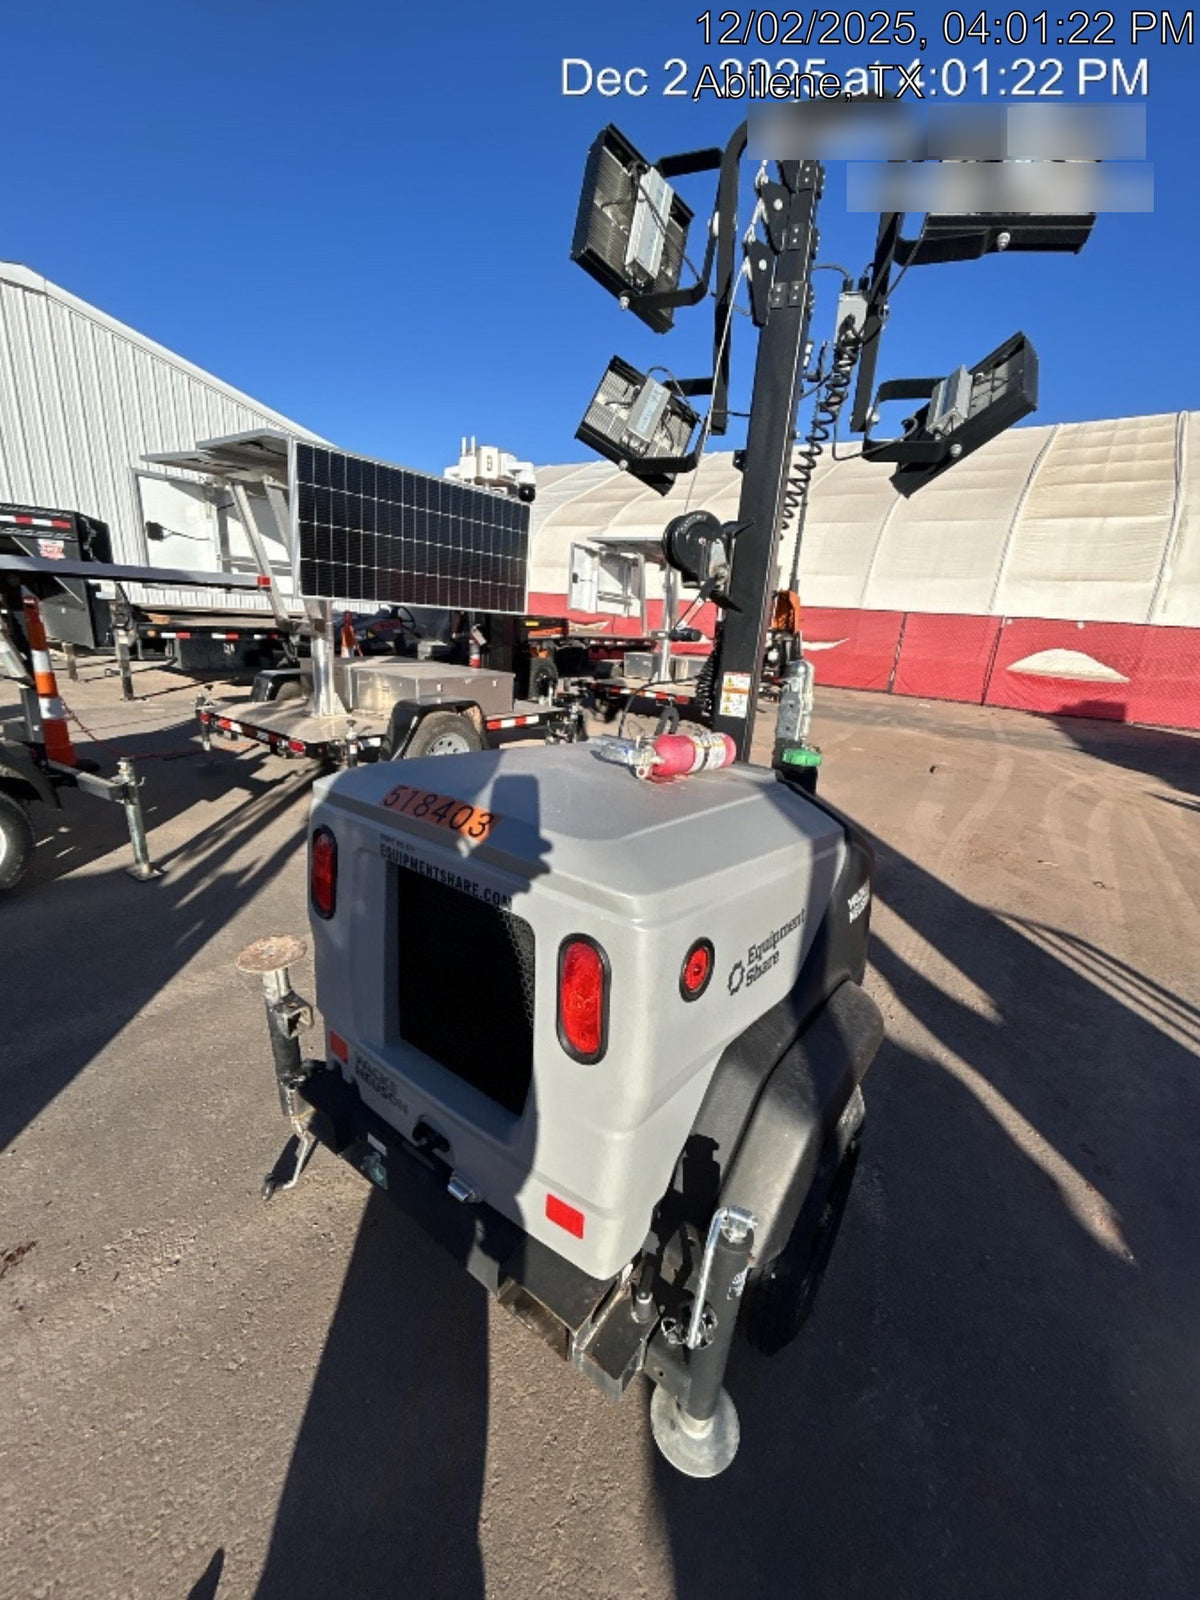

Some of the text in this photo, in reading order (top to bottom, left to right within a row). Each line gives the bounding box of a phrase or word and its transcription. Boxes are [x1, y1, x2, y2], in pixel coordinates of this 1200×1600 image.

[383, 785, 494, 838] 518403
[748, 908, 805, 966] Equipment
[746, 951, 780, 987] Share
